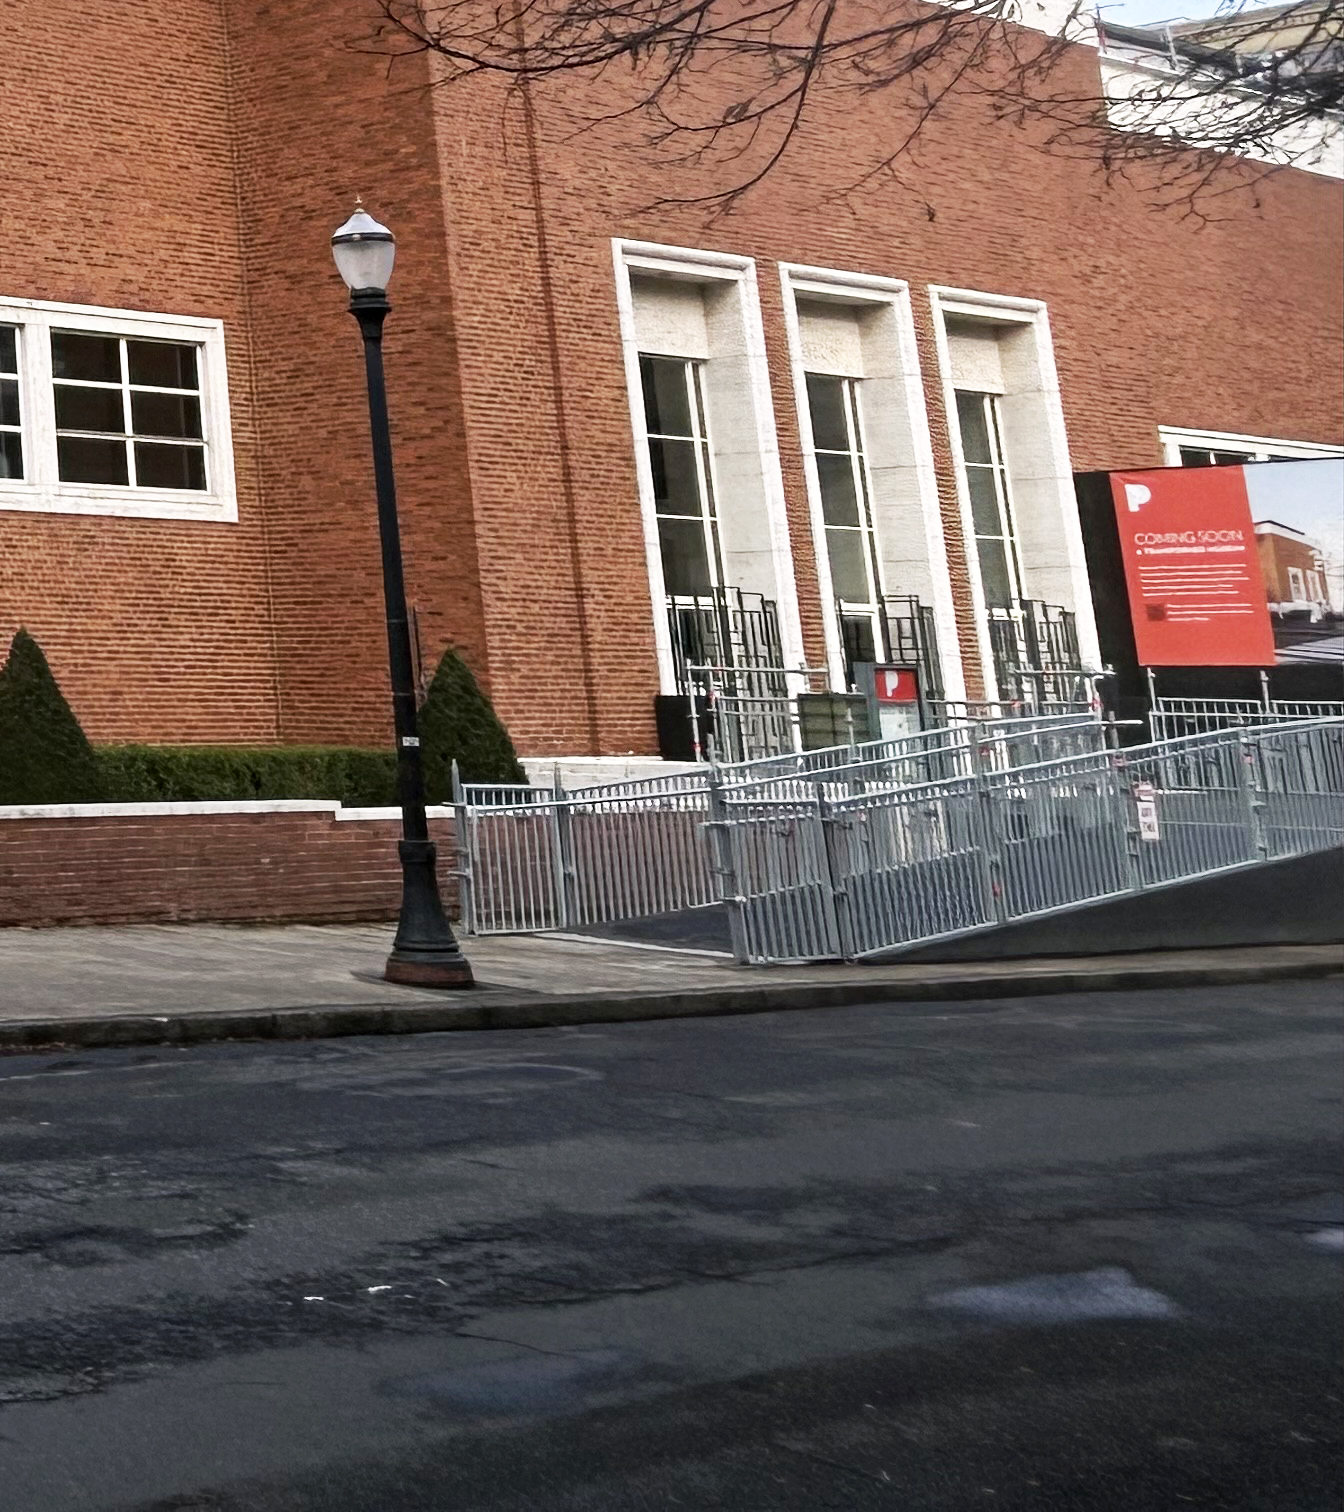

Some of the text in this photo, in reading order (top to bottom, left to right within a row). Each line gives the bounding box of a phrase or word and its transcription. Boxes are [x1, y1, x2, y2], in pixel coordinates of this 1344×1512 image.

[1124, 483, 1152, 512] P
[1134, 530, 1244, 545] COMING SOON
